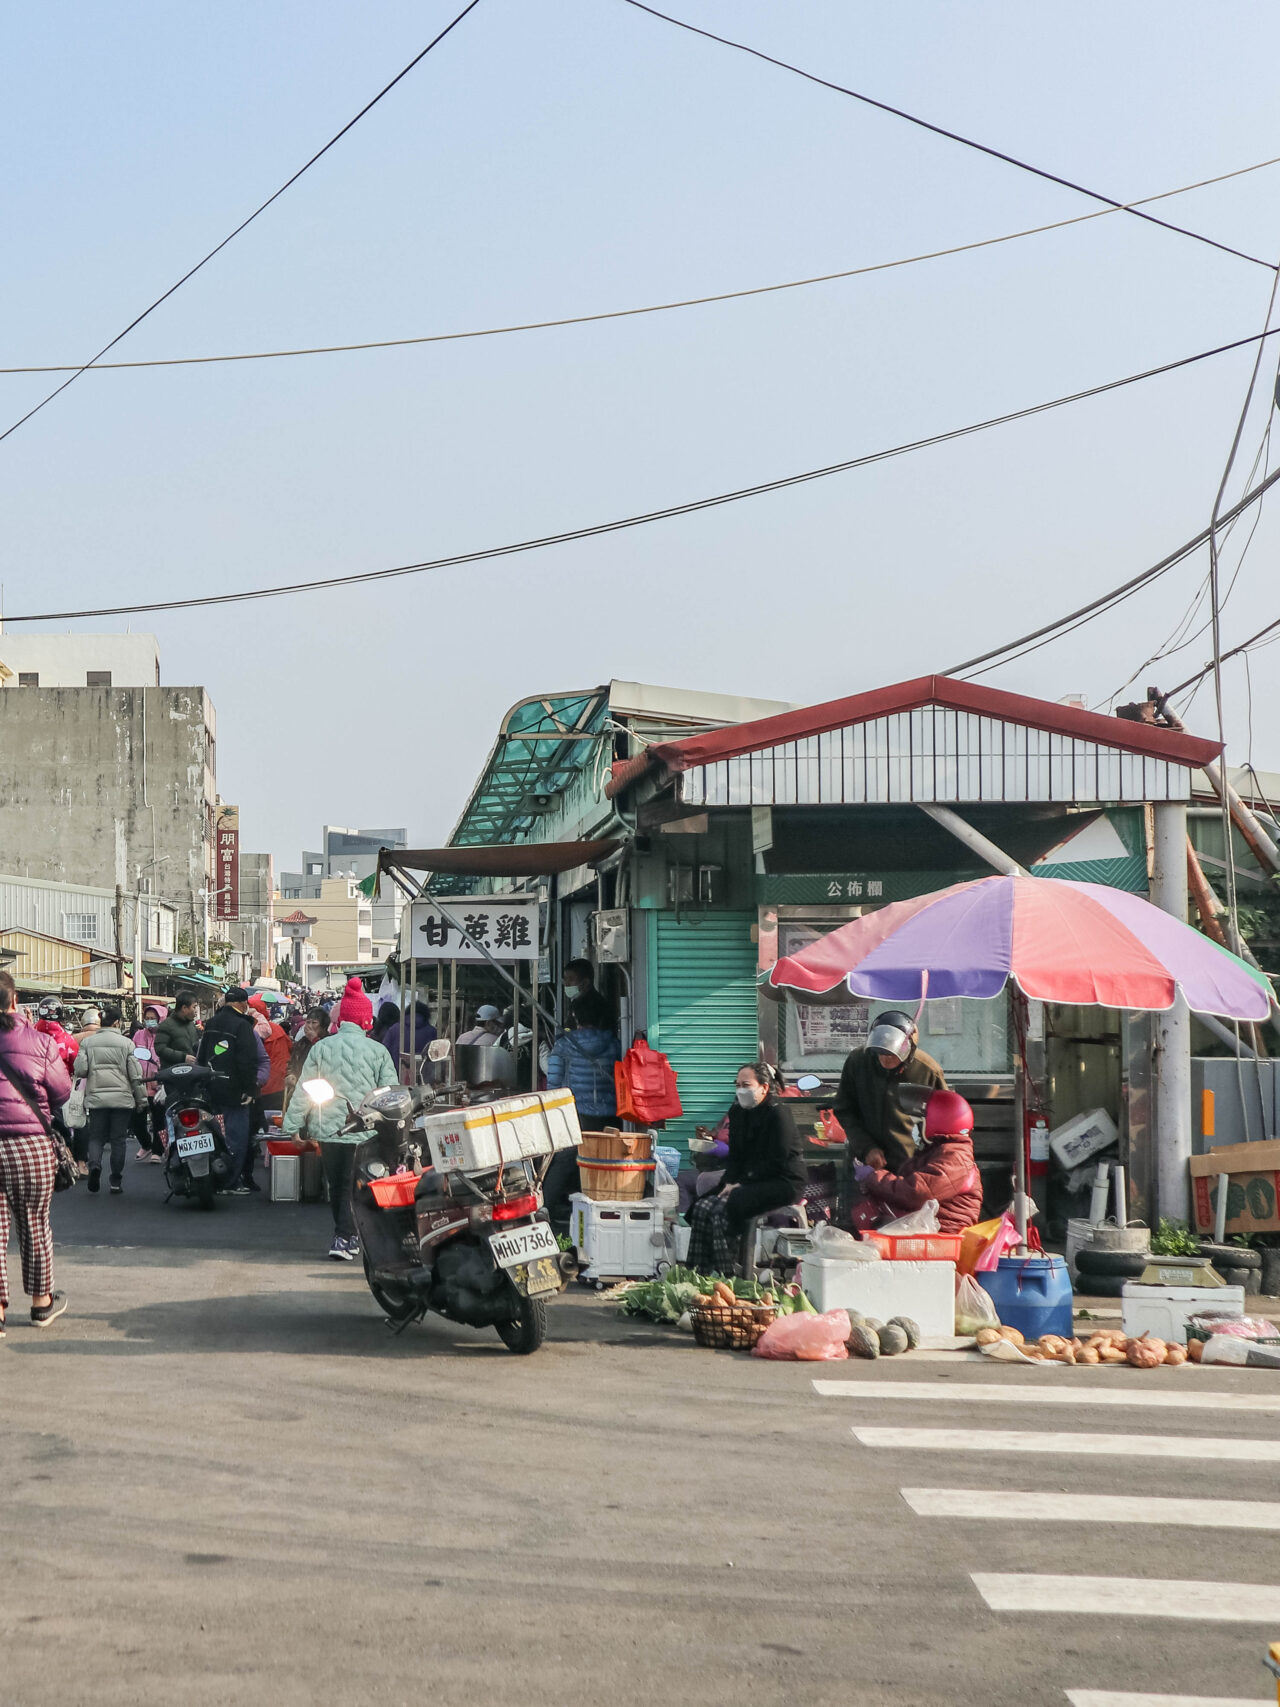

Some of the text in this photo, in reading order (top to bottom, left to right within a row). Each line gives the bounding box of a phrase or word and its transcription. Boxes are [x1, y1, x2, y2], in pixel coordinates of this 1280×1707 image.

[220, 833, 235, 862] 朋富
[827, 881, 883, 897] 公佈欄
[419, 914, 532, 950] 甘蔗雞
[493, 1230, 554, 1260] MHU-7386
